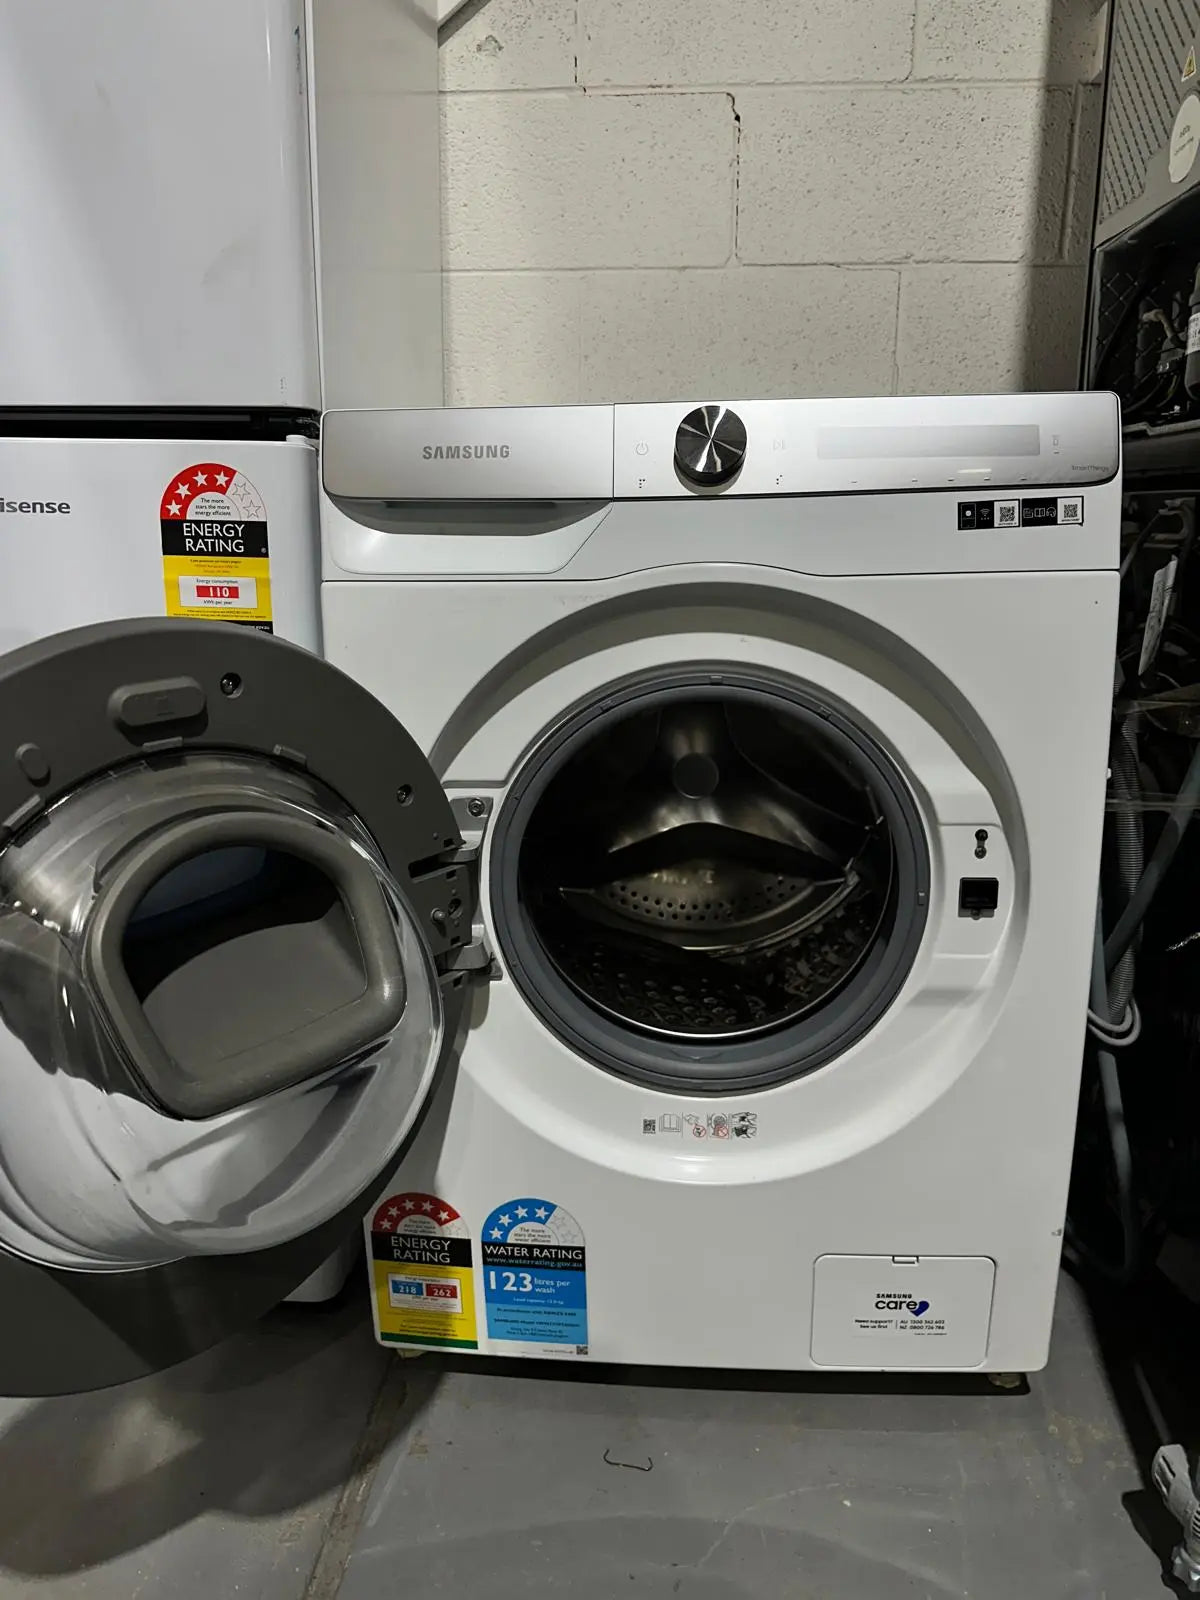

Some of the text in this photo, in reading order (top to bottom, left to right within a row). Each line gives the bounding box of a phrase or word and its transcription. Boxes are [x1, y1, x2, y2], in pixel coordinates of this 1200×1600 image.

[422, 444, 510, 460] SAMSUNG
[0, 497, 71, 514] isense
[182, 522, 245, 537] ENERGY
[185, 538, 245, 553] RATING
[209, 586, 230, 598] 110
[391, 1235, 451, 1251] ENERGY
[393, 1248, 450, 1264] RATING
[484, 1245, 583, 1260] WATER RATING
[486, 1257, 583, 1268] www.waterrating.gov.au
[489, 1270, 533, 1292] 123
[534, 1277, 571, 1289] litres per
[399, 1285, 417, 1294] 218
[432, 1288, 451, 1297] 262
[535, 1286, 556, 1294] wash
[874, 1299, 918, 1311] care
